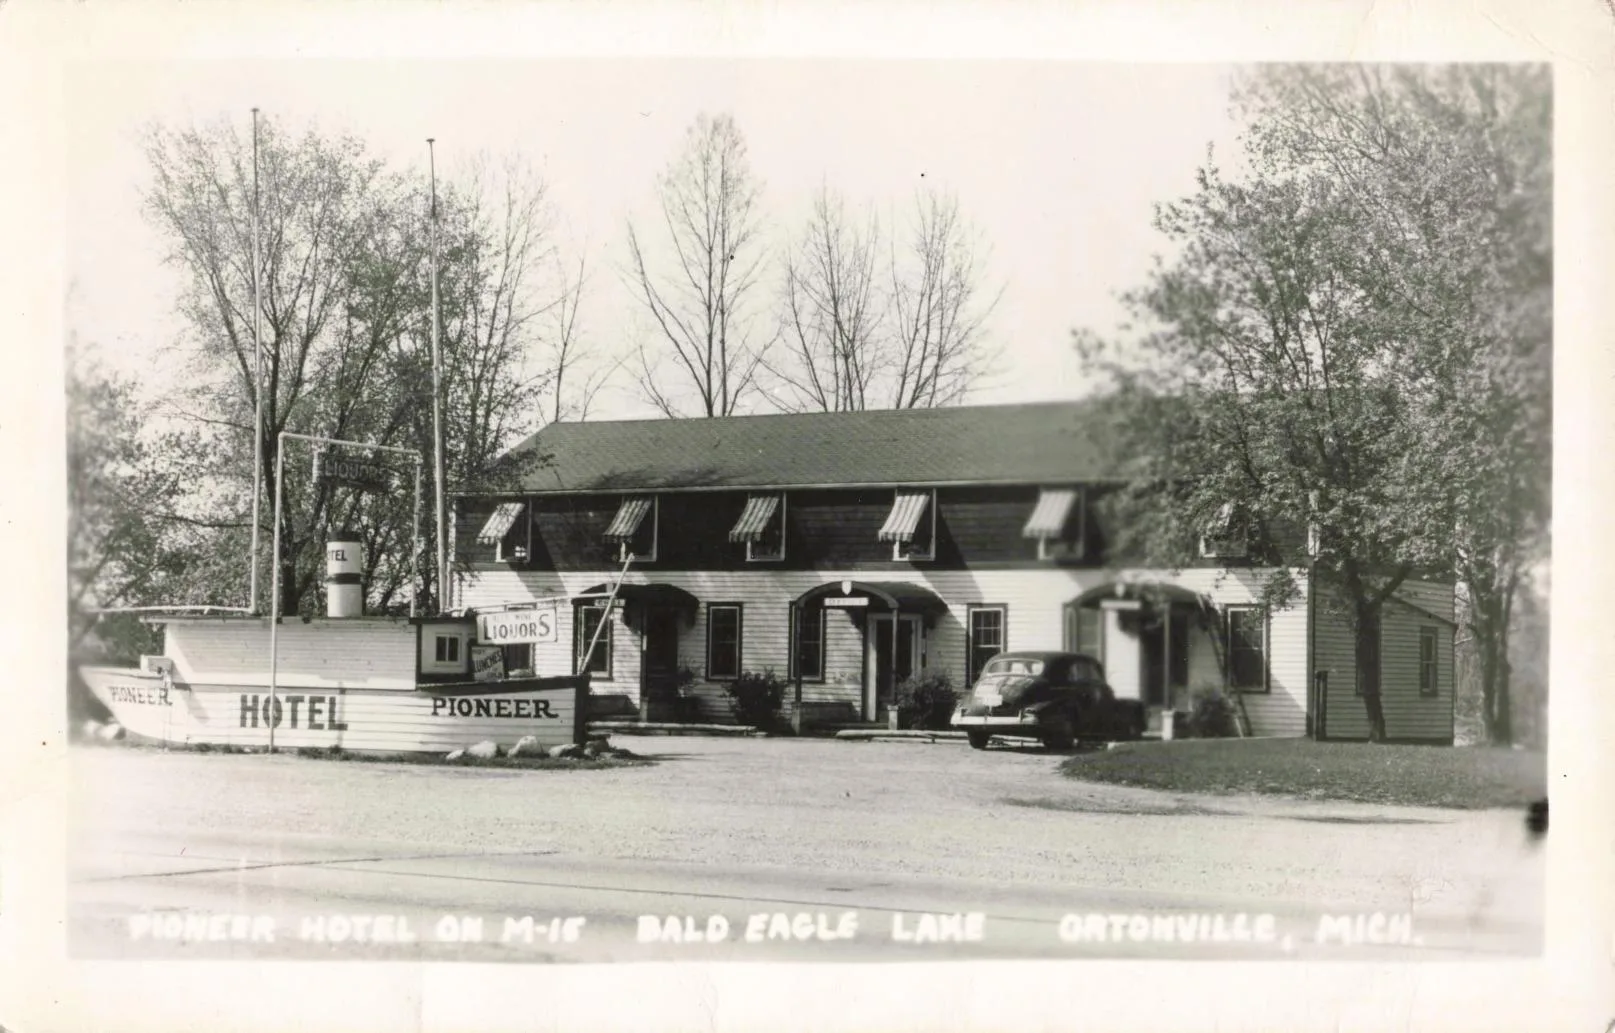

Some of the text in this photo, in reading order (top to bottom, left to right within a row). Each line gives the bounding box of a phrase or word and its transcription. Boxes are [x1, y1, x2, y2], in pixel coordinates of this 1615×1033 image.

[483, 613, 550, 641] LIQUORS
[240, 694, 348, 731] HOTEL
[431, 696, 559, 719] PIONEER
